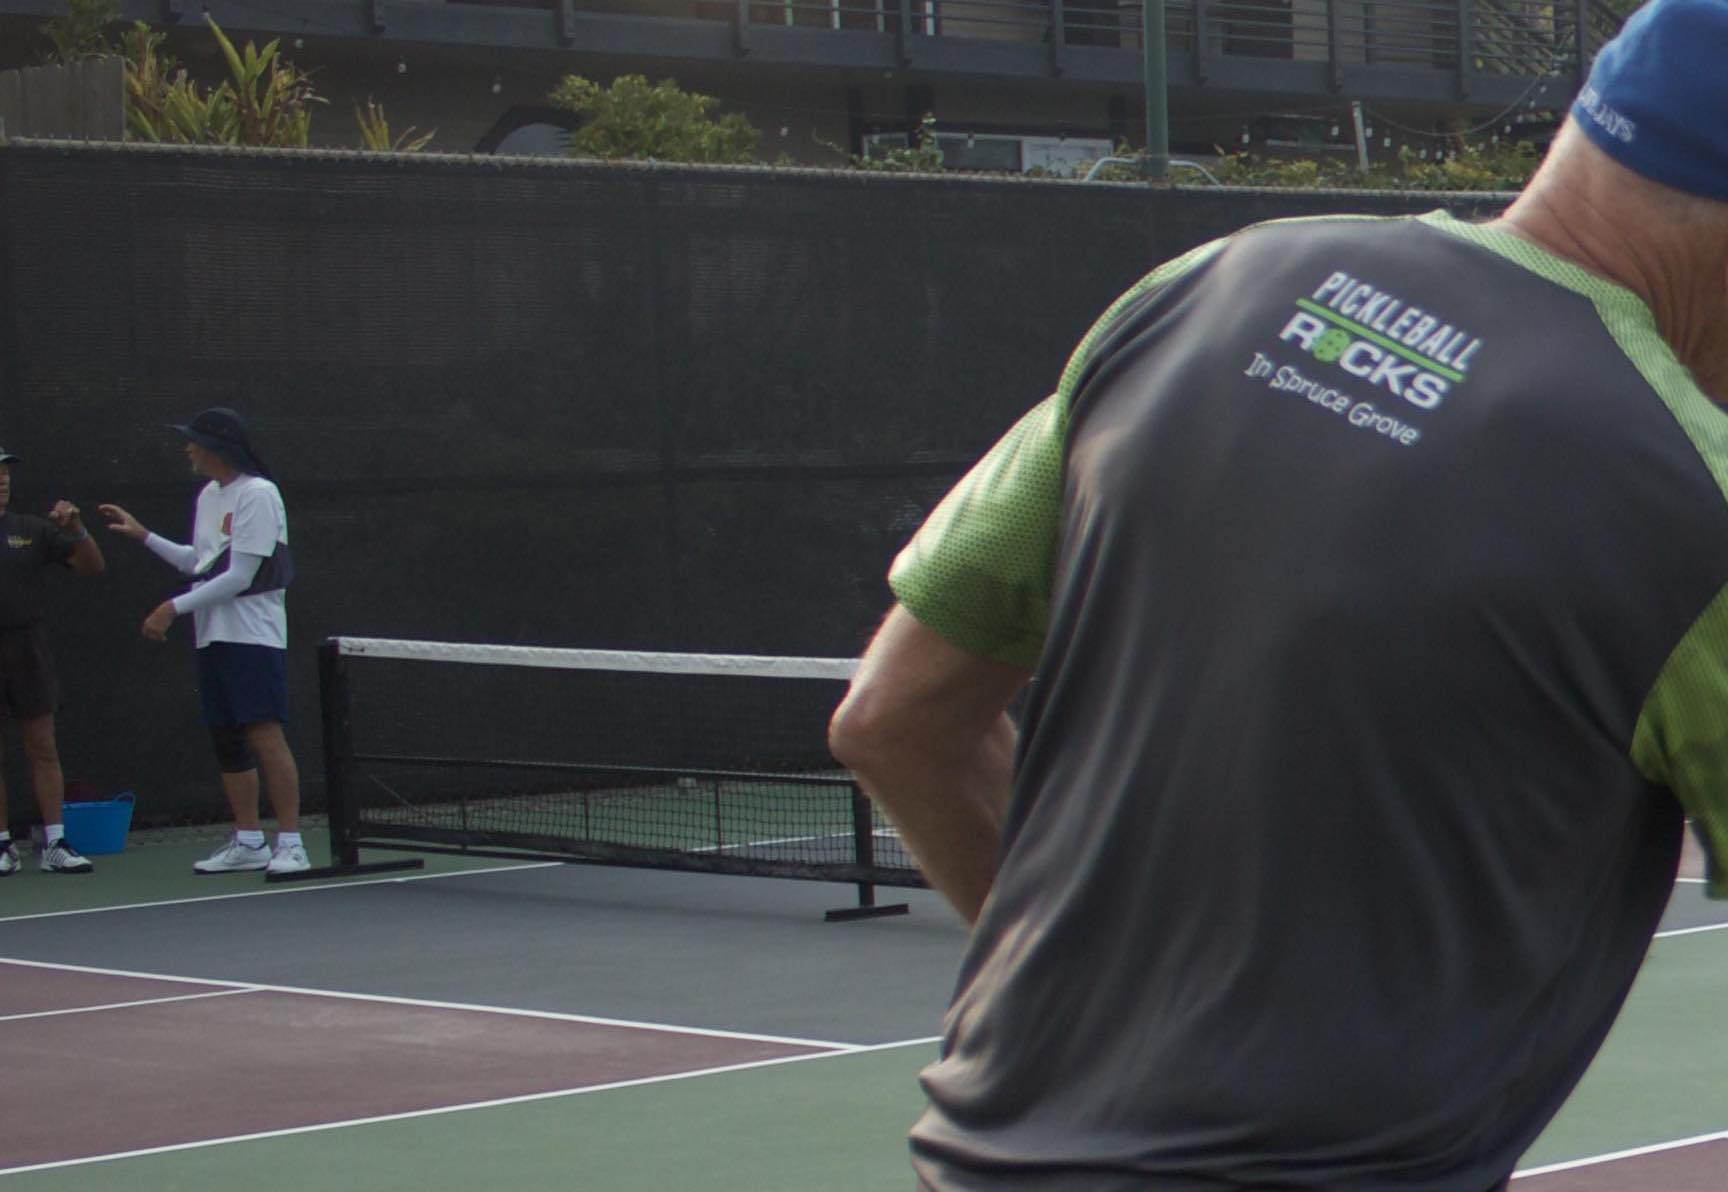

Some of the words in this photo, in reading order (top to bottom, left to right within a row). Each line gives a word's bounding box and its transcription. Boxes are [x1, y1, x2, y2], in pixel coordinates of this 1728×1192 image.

[1312, 271, 1484, 371] PICKLEBALL
[1244, 352, 1274, 378] In
[1268, 365, 1351, 414] Spruce
[1347, 401, 1422, 447] Grove
